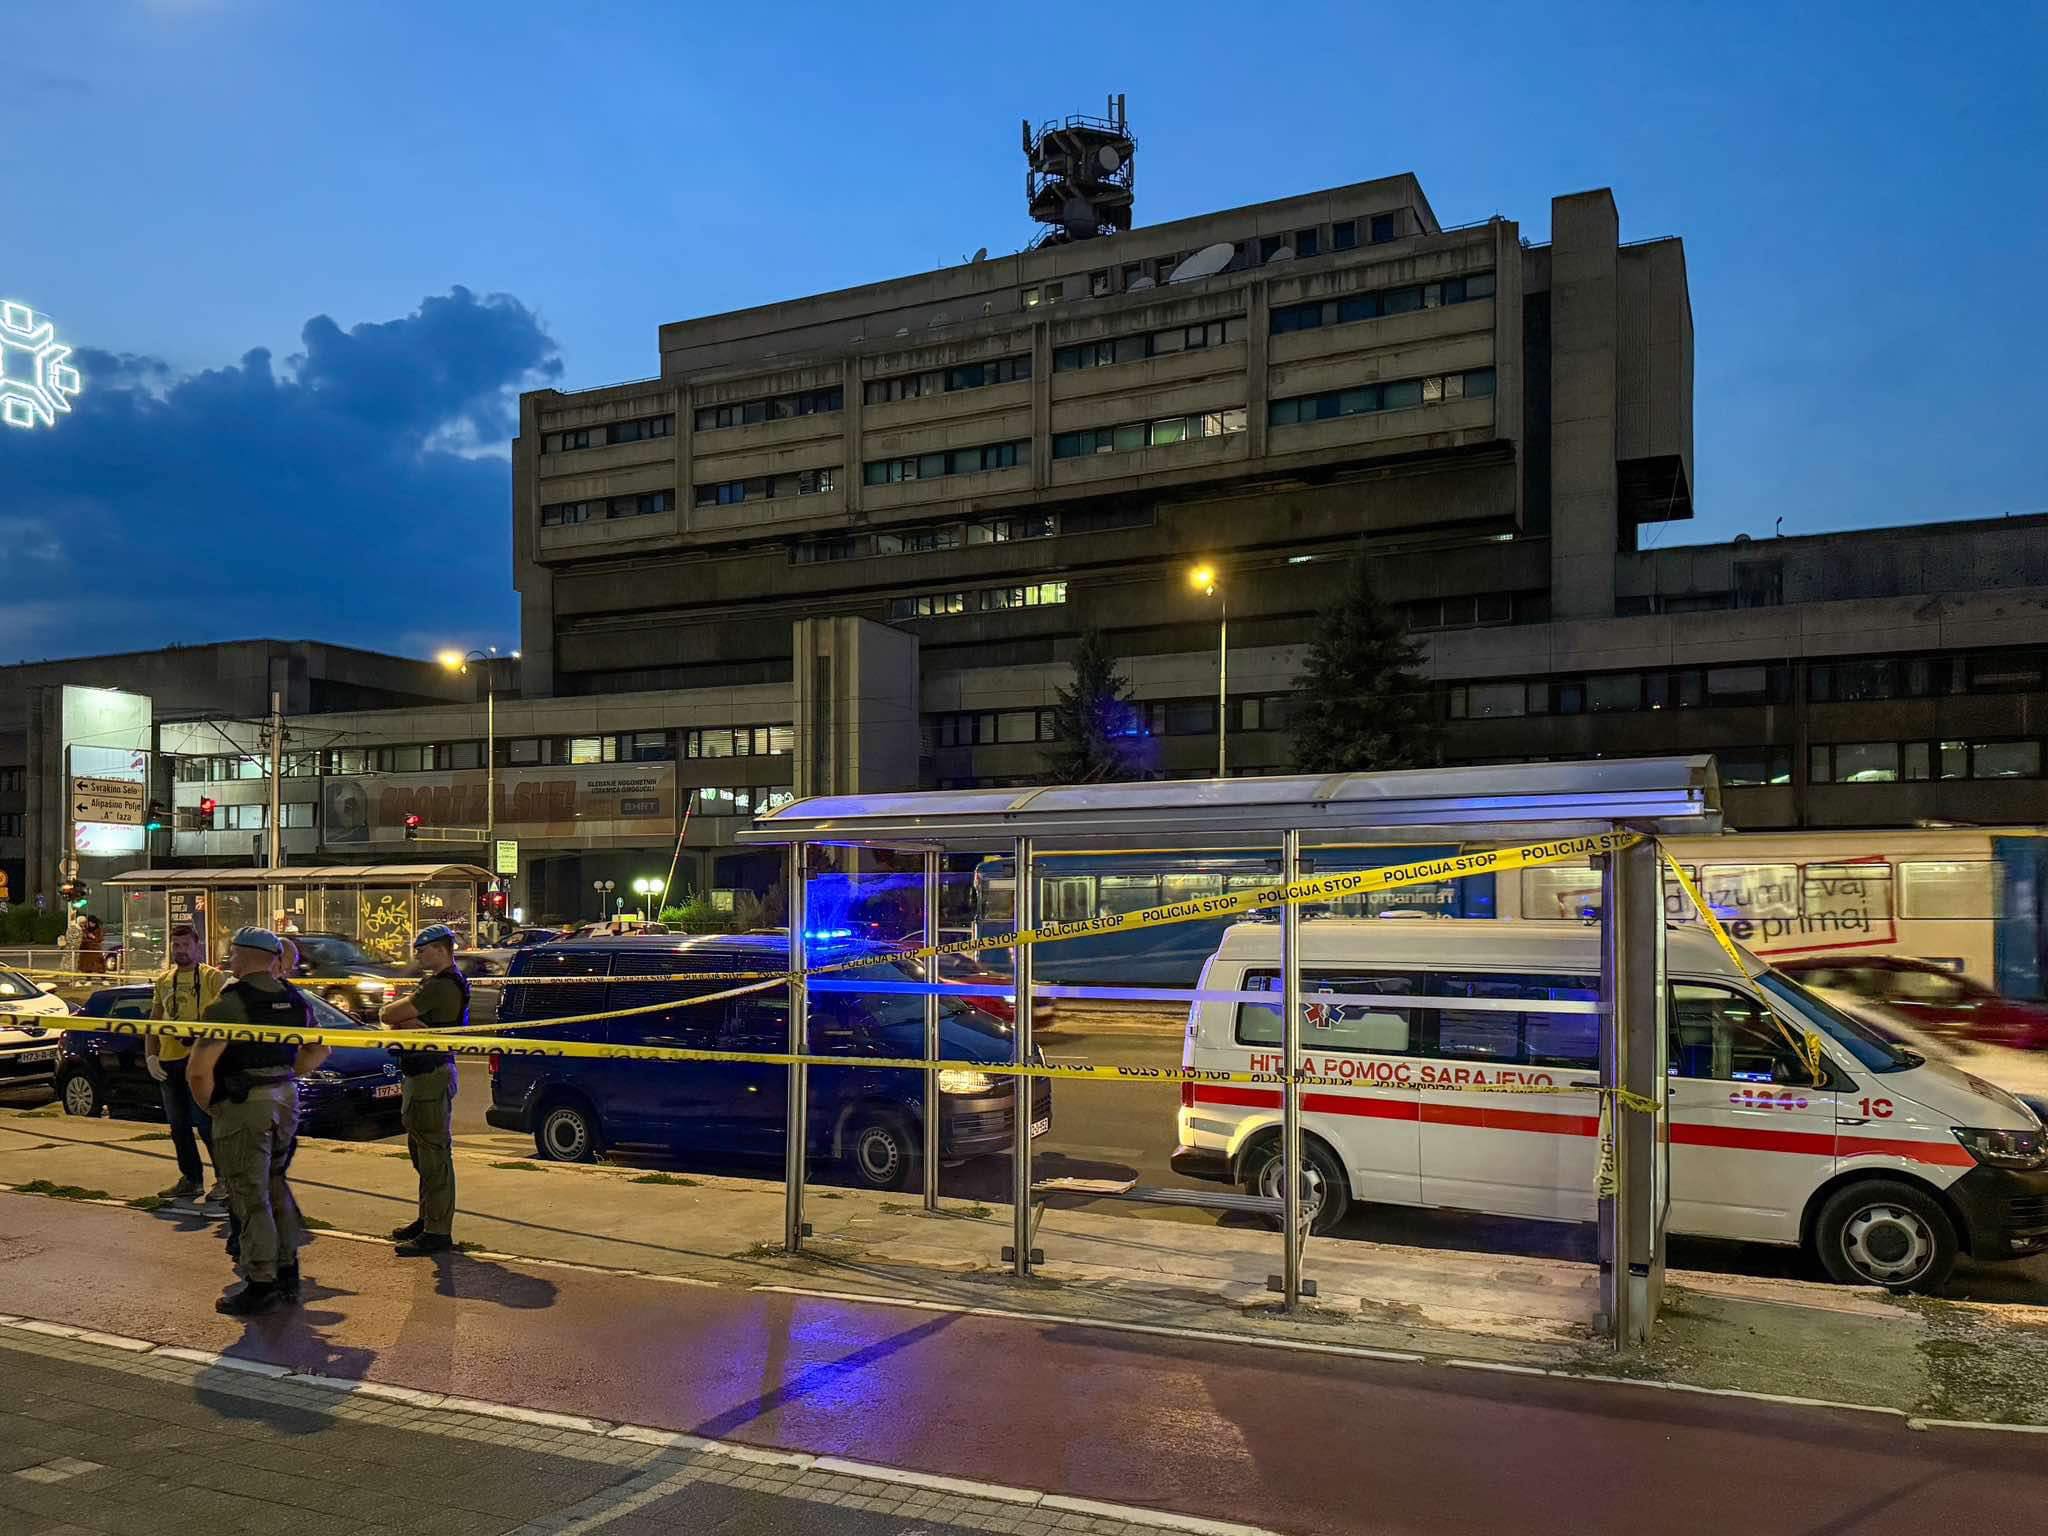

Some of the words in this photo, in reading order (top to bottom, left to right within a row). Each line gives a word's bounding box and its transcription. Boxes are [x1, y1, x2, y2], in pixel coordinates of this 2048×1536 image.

[1521, 839, 1596, 860] POLICIJA
[1384, 862, 1453, 884] POLICIJA
[1456, 853, 1497, 870] STOP
[1258, 886, 1318, 903] POLICIJA
[1324, 875, 1361, 892] STOP
[1142, 904, 1200, 922] POLICIJA
[1203, 896, 1238, 912] STOP
[1035, 923, 1089, 939] POLICIJA
[1091, 915, 1124, 930] STOP
[891, 949, 920, 961] STOP
[935, 941, 985, 955] POLICIJA
[989, 932, 1018, 946] STOP
[1324, 1057, 1411, 1084] POMOĆ
[1421, 1064, 1552, 1086] SARAJEVO
[1743, 1090, 1793, 1110] 124
